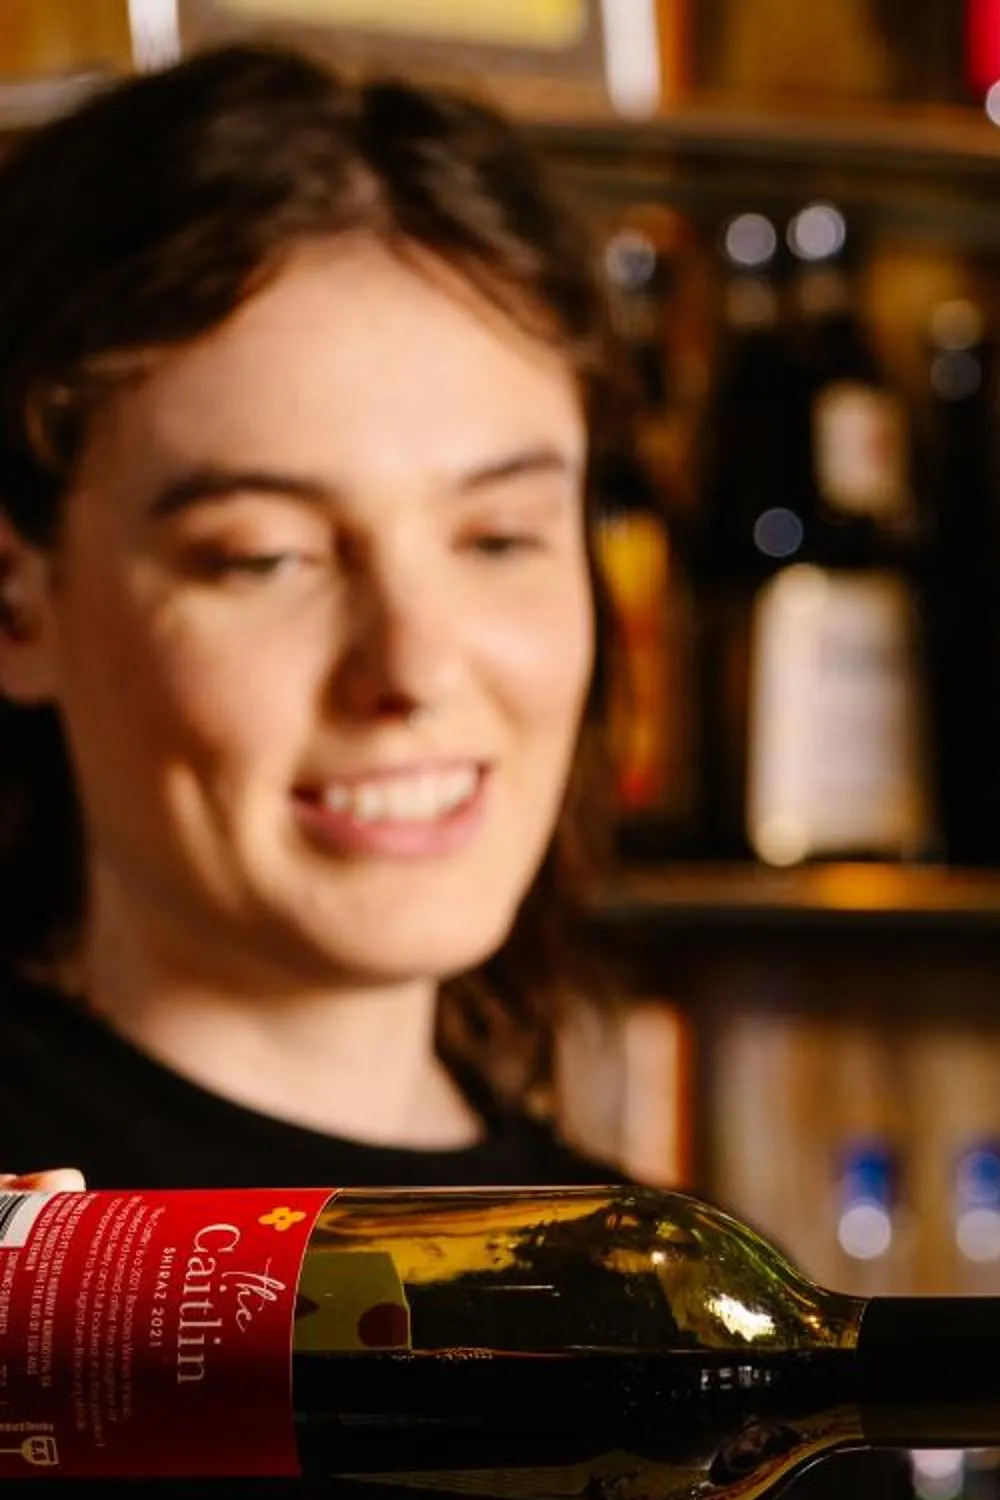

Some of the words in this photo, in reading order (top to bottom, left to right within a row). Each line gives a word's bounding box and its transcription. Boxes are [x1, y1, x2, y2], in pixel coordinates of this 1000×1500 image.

[153, 1246, 177, 1301] SHIRAZ
[176, 1224, 241, 1384] Caitlin
[222, 1257, 286, 1332] the
[148, 1306, 165, 1348] 2021
